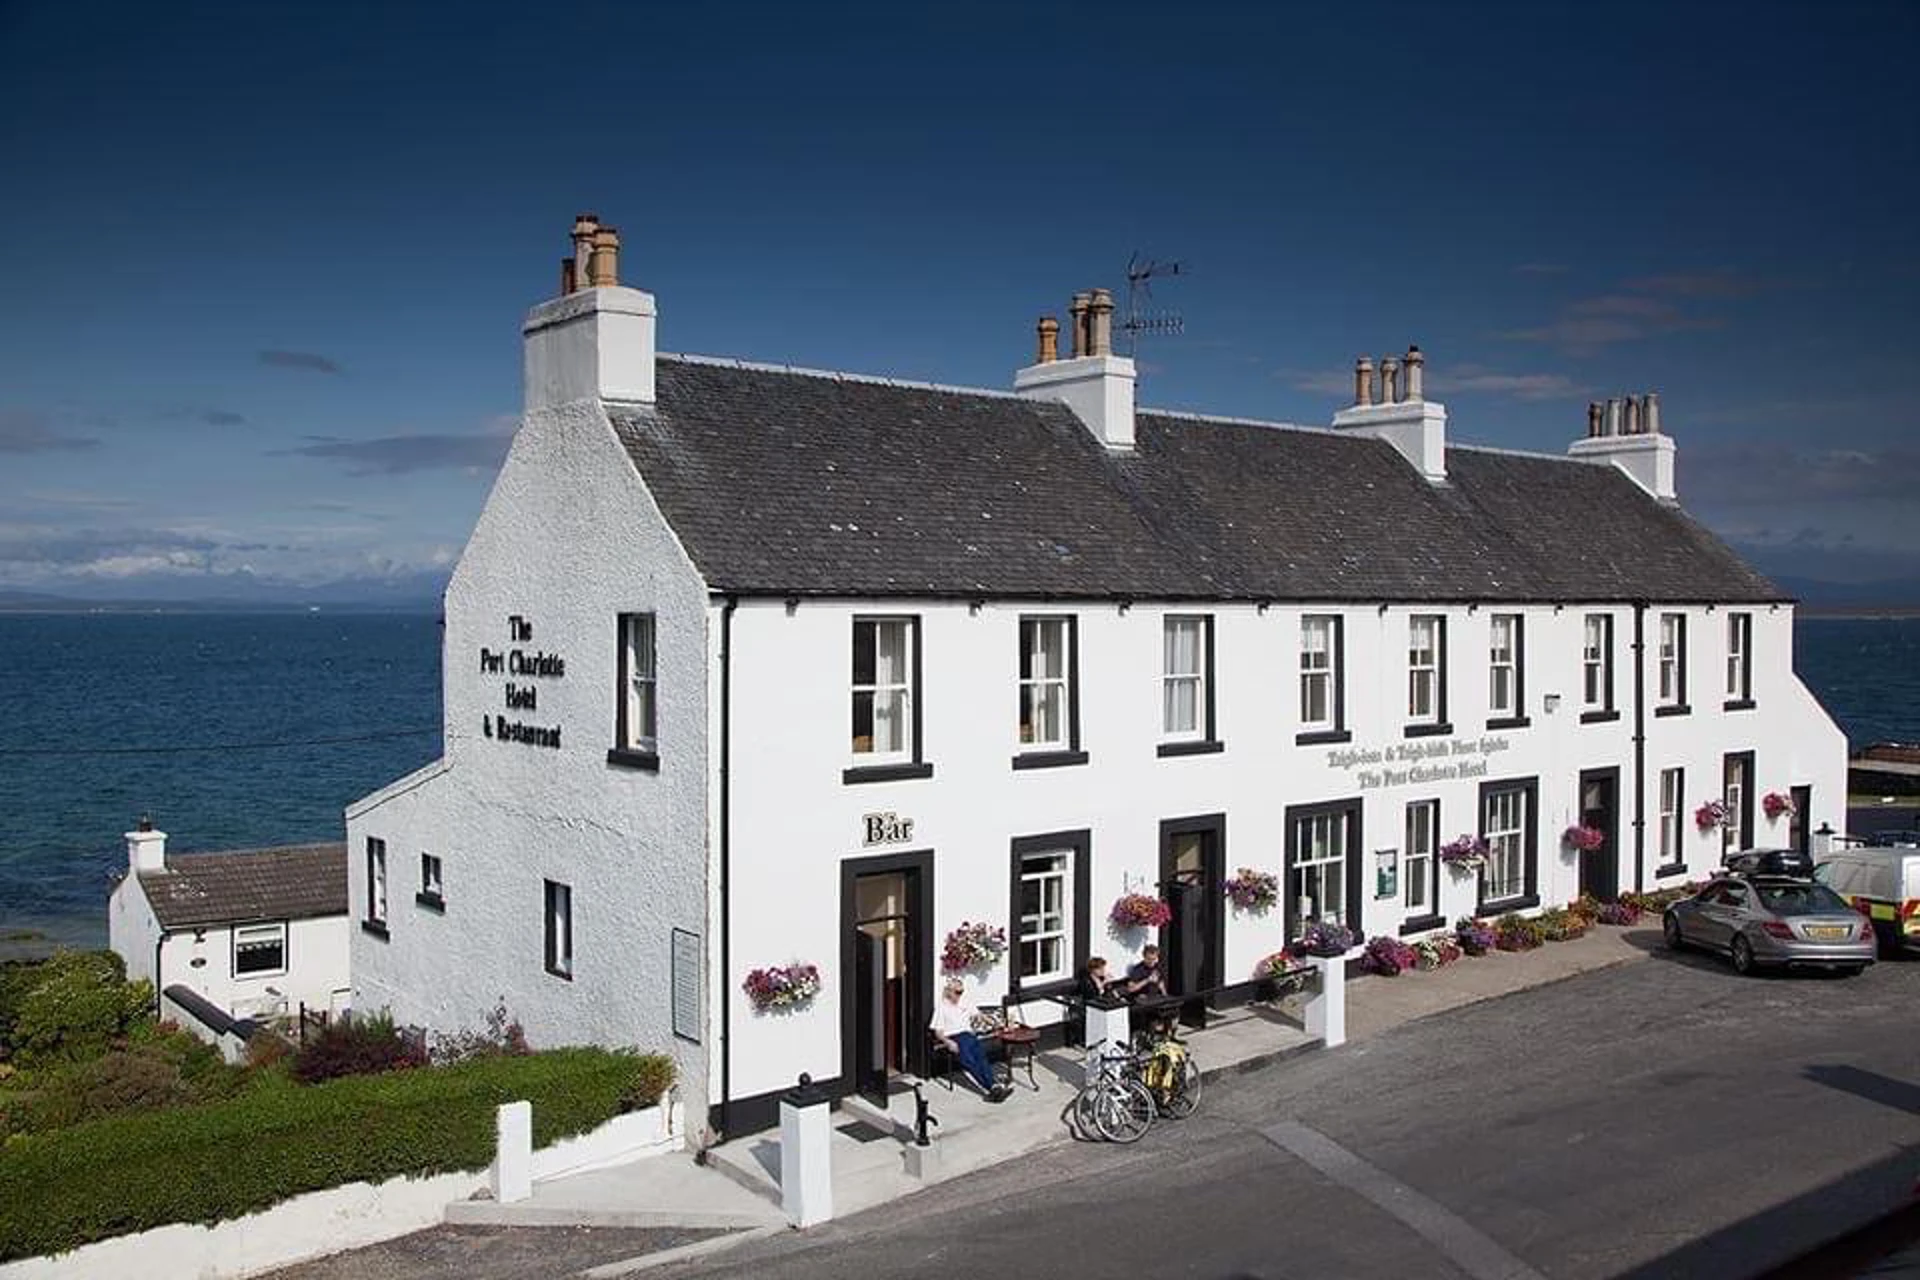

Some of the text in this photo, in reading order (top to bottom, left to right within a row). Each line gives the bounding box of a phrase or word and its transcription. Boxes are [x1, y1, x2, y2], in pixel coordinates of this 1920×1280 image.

[508, 615, 532, 641] The
[480, 647, 566, 678] Port Charlotte
[506, 682, 537, 711] Hotel
[497, 714, 561, 749] Restaurant
[1385, 745, 1395, 762] &
[1357, 759, 1487, 790] The Port Charlotte Hotel
